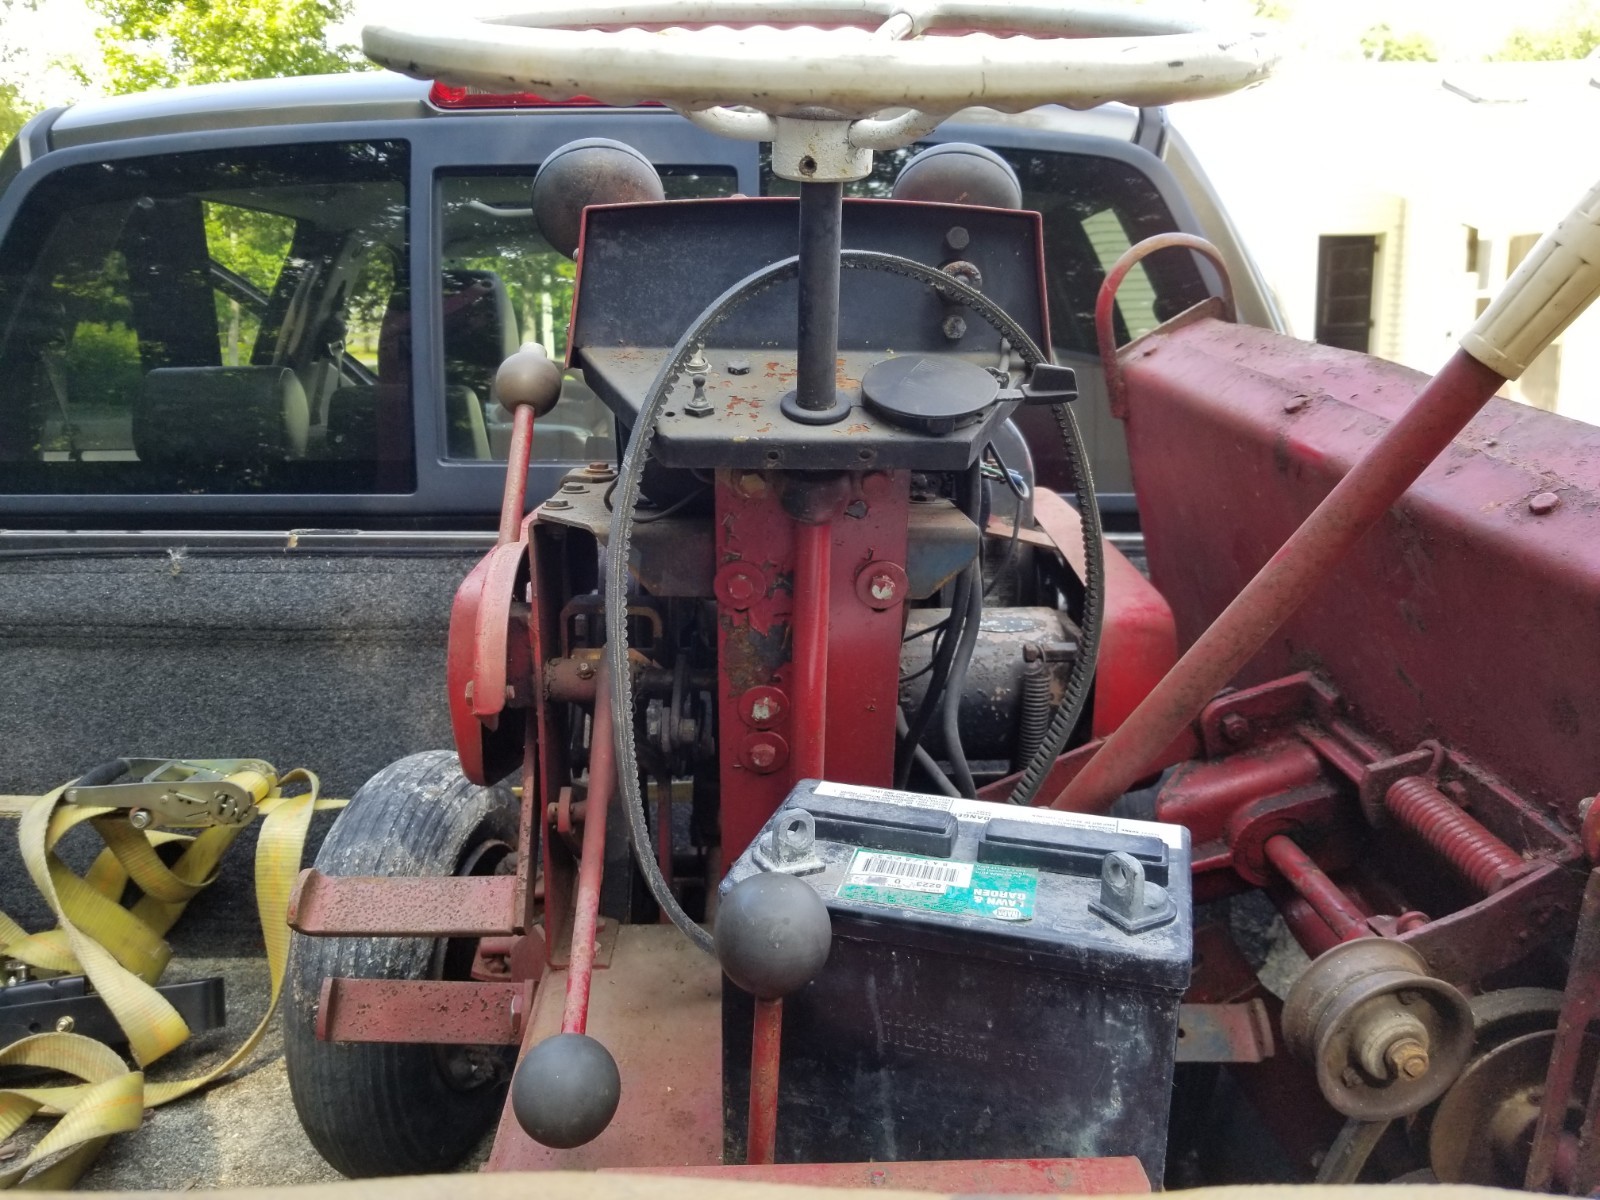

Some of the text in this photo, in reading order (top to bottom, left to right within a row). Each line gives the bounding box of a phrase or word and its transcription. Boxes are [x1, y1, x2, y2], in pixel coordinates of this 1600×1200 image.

[973, 888, 1027, 900] GARDEN
[974, 895, 1025, 908] LAWN &
